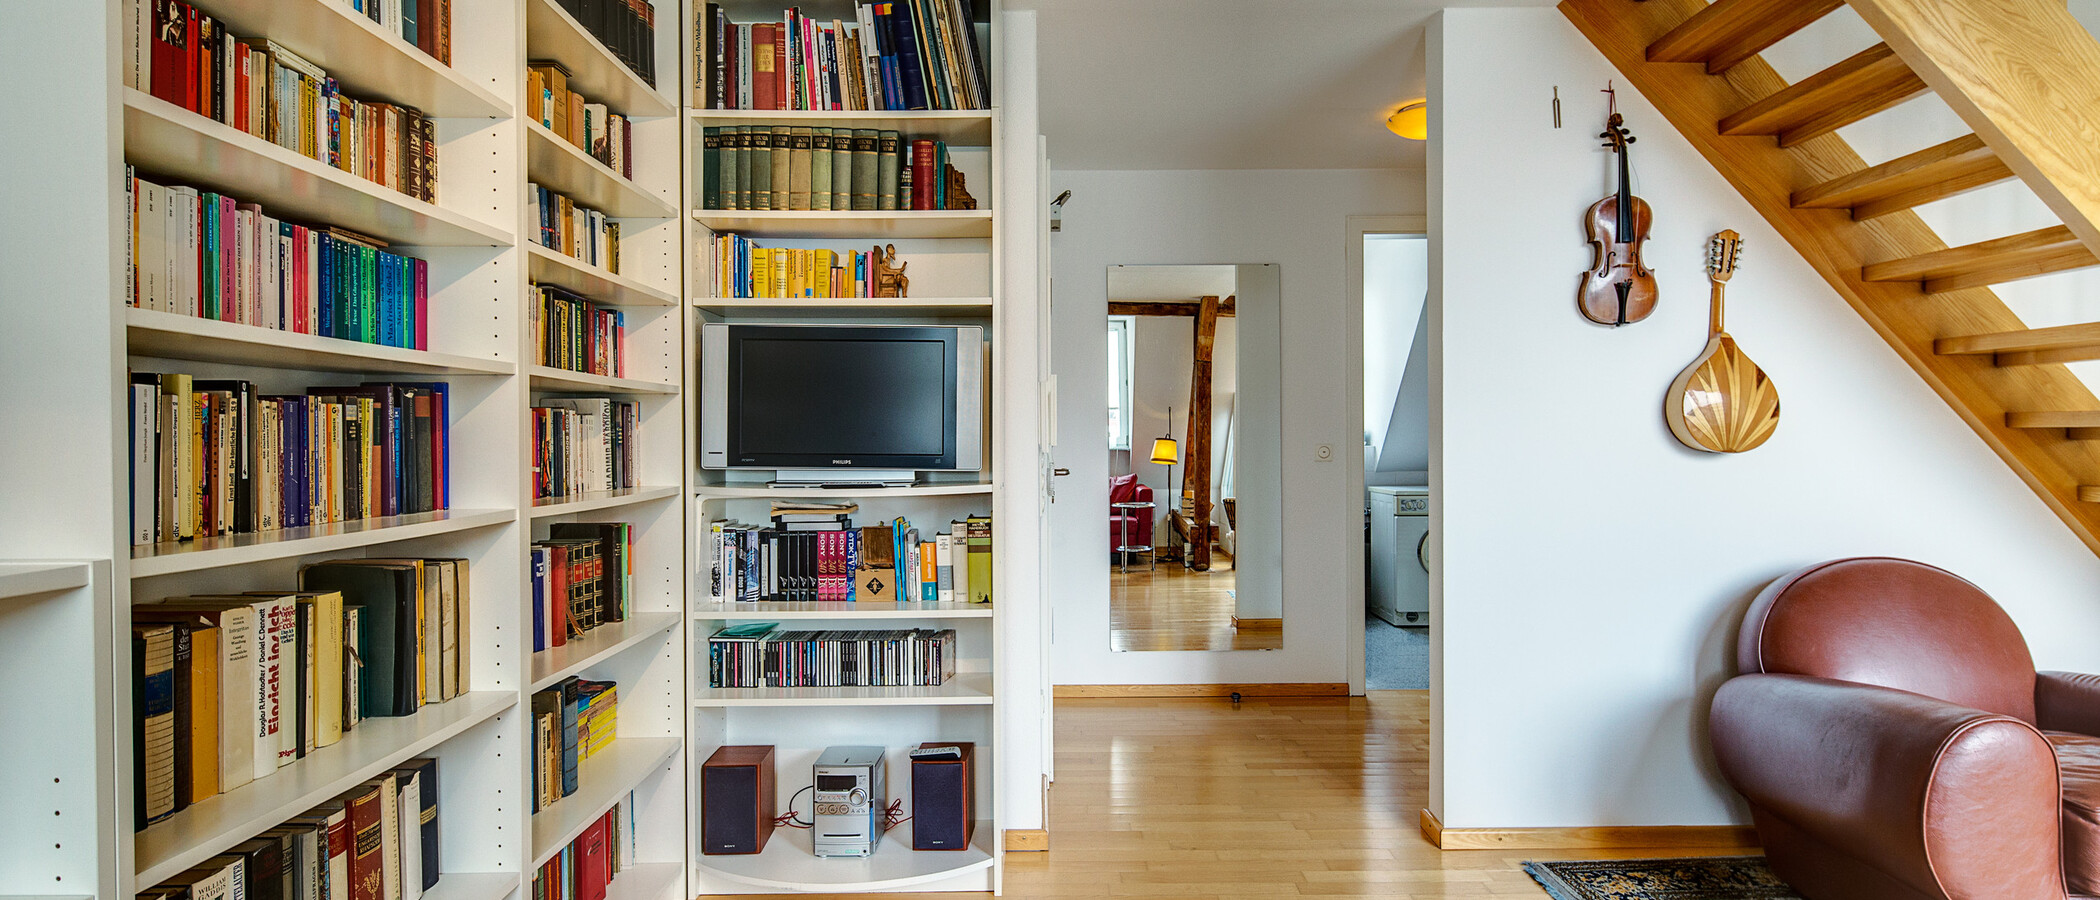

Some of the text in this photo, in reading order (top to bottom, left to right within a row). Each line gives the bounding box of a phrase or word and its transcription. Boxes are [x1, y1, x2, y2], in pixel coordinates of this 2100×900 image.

[228, 432, 236, 459] künstliche
[818, 559, 827, 574] 240
[827, 559, 837, 574] 240
[837, 559, 846, 574] 240
[267, 604, 280, 735] Einsicht ins Ich
[259, 710, 268, 738] Douglas
[198, 876, 227, 895] WILLIAM
[198, 883, 226, 900] GADDIS
